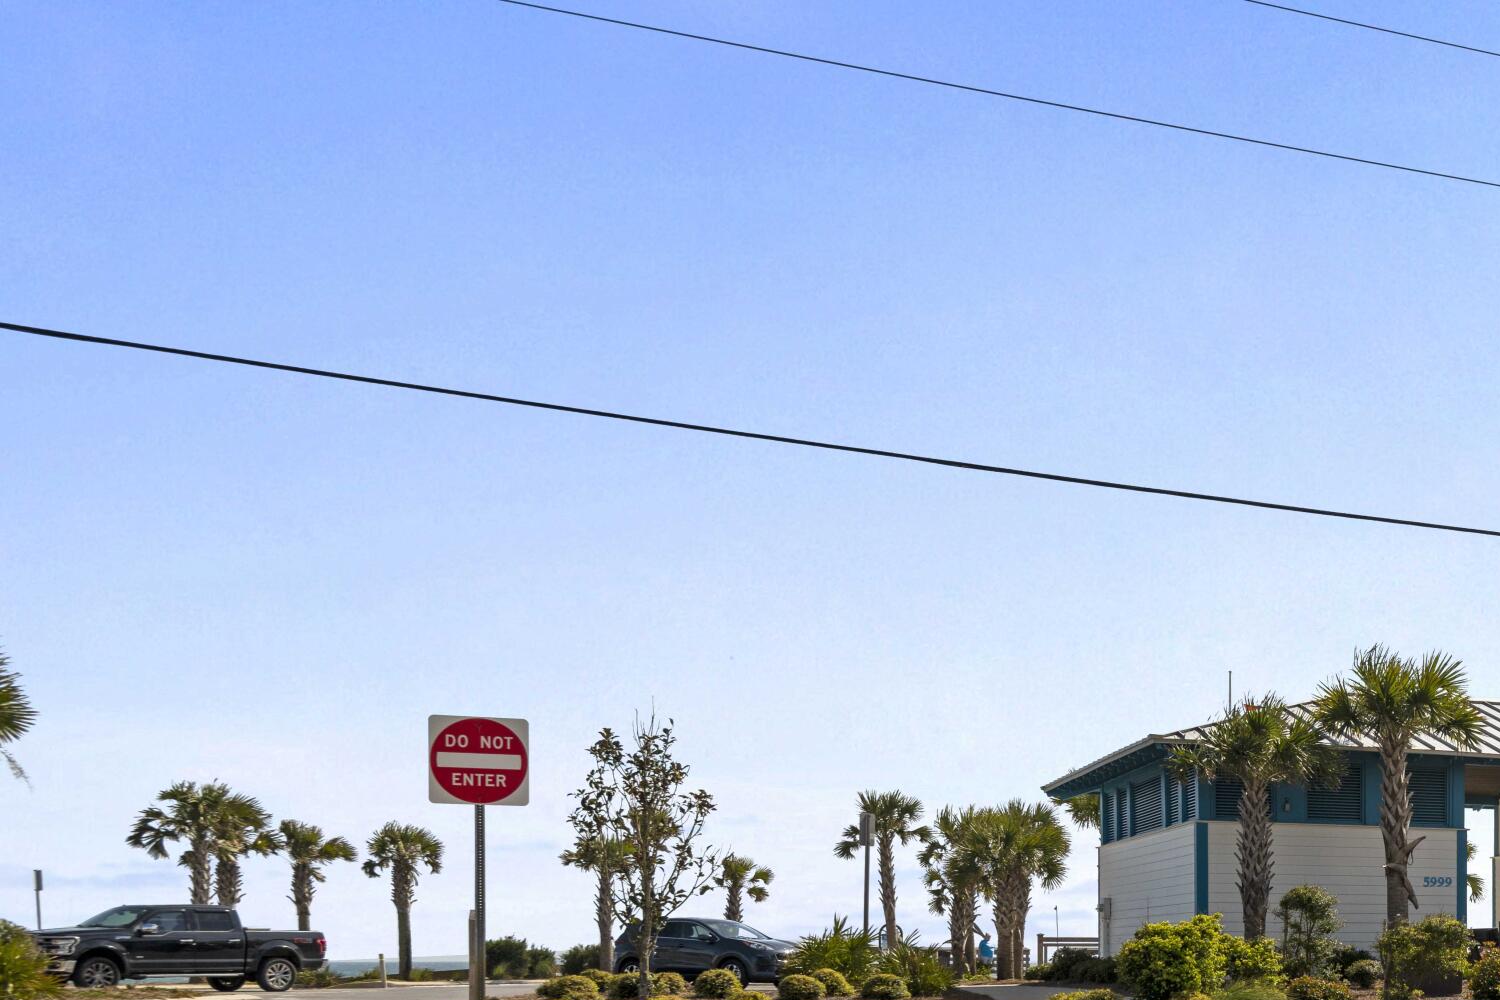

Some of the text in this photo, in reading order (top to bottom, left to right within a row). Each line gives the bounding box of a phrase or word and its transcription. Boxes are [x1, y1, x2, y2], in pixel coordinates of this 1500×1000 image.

[445, 734, 513, 750] DO NOT
[451, 772, 507, 788] ENTER
[1423, 876, 1453, 888] 5999
